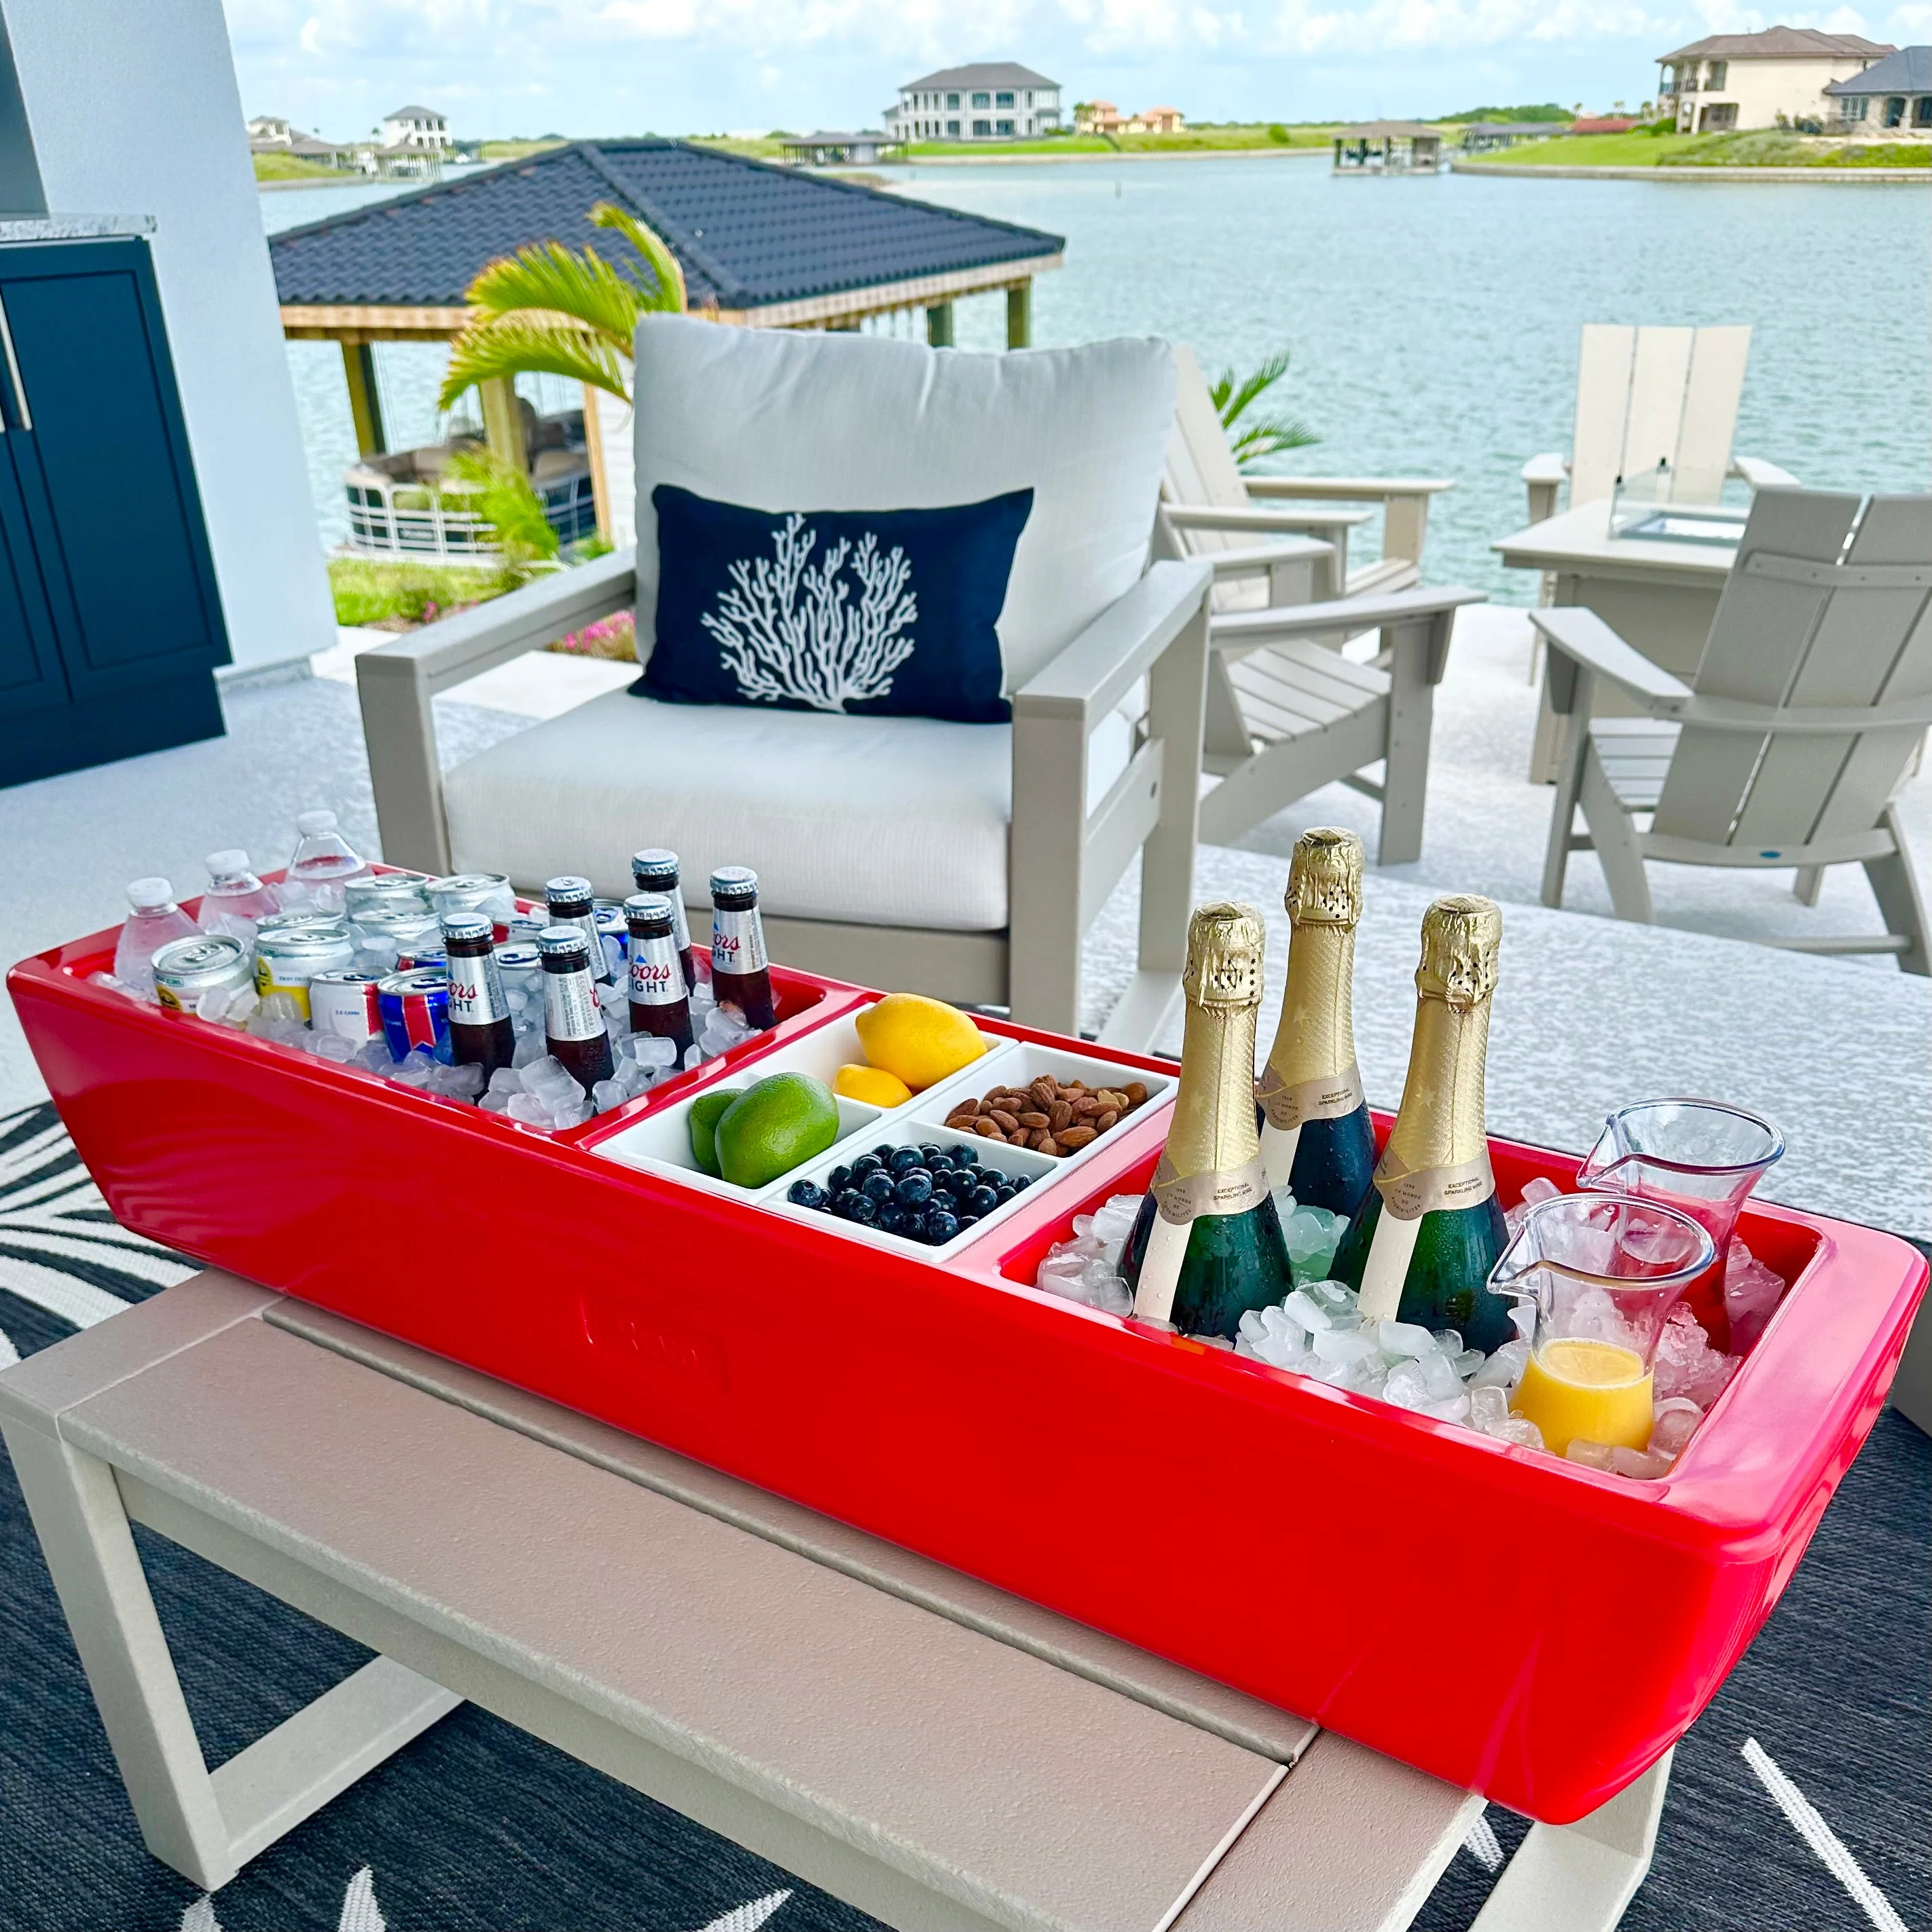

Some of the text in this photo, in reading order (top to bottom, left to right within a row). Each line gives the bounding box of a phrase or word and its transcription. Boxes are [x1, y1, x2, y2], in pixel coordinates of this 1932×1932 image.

[714, 934, 740, 951] ors
[449, 983, 478, 999] ors
[630, 979, 667, 993] IGHT
